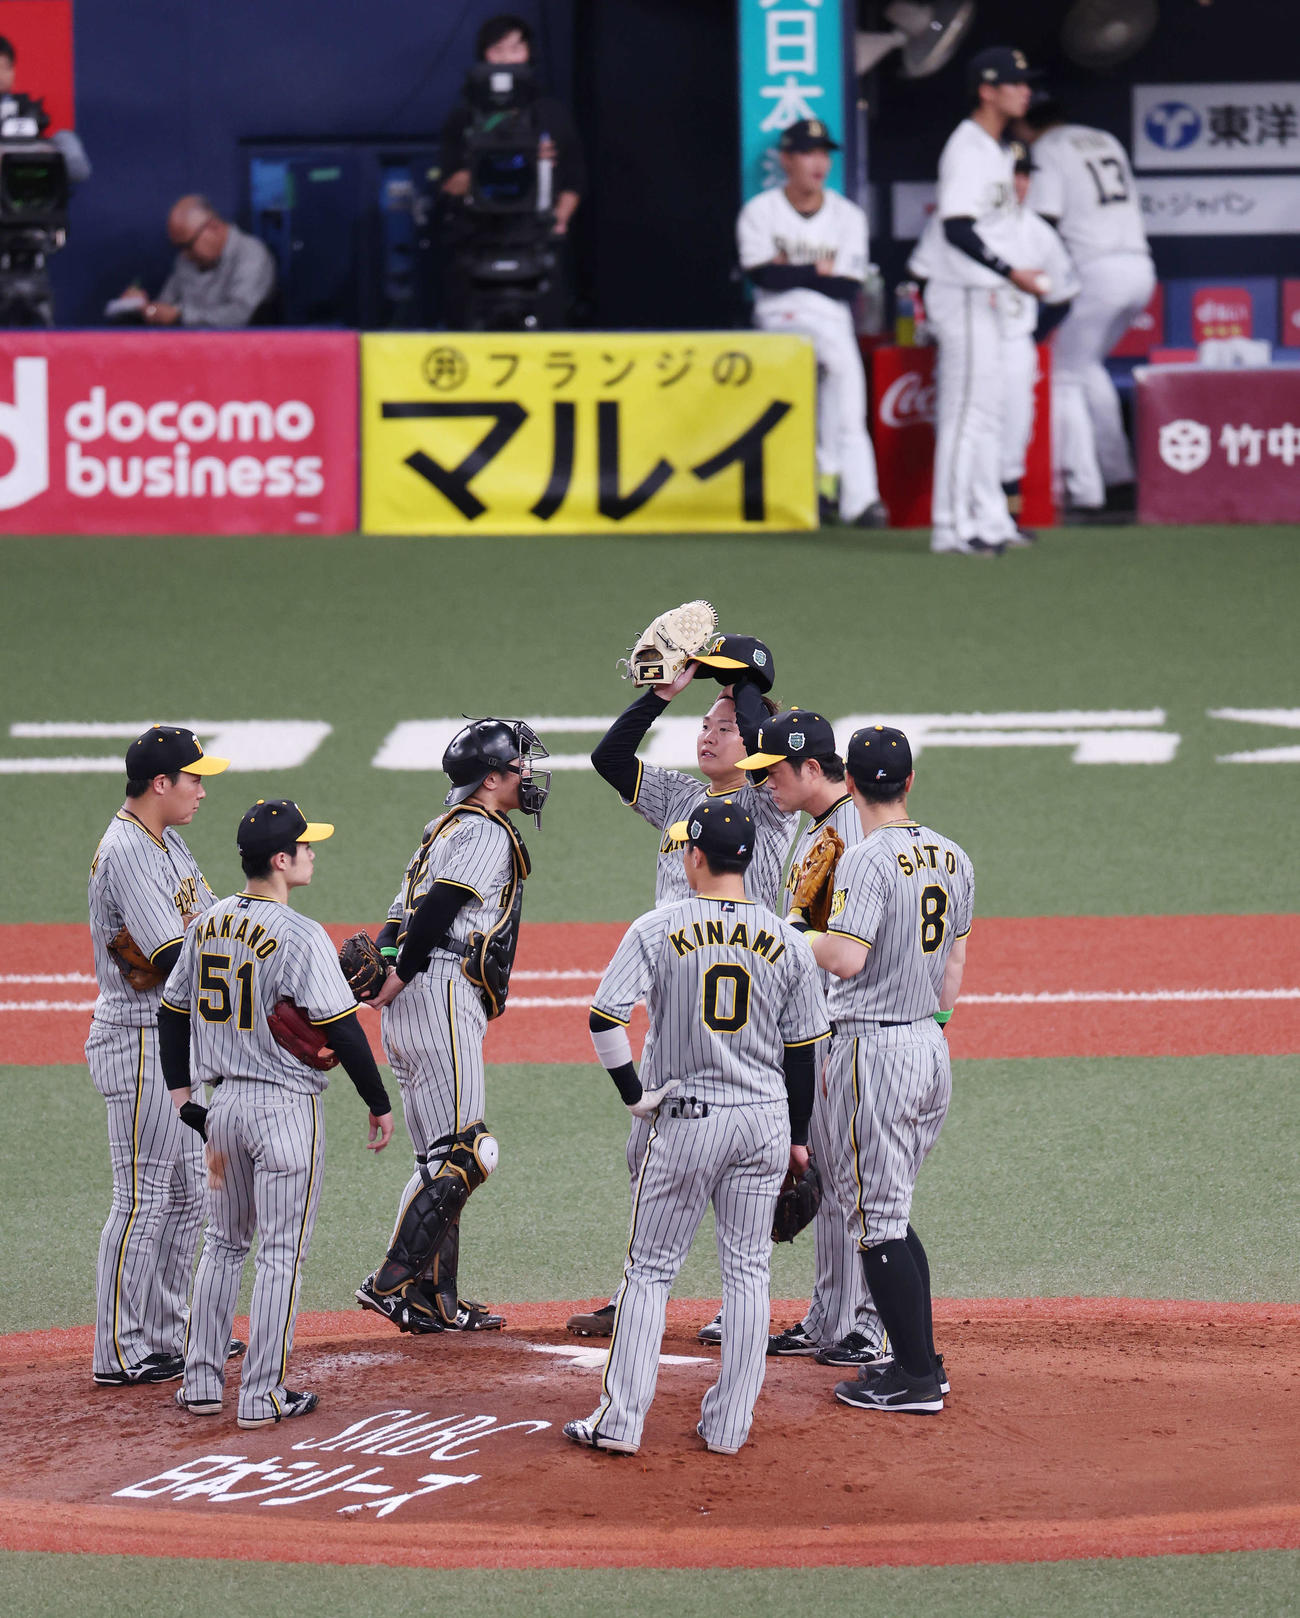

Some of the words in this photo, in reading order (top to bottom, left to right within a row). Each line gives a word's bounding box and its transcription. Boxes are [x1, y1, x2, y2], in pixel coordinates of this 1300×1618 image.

[1208, 104, 1298, 147] 東洋
[1085, 157, 1128, 206] 13
[489, 350, 754, 388] フランジの
[65, 386, 314, 442] docomo
[66, 442, 324, 497] business
[381, 399, 794, 522] マルイ
[1219, 422, 1300, 466] 竹中
[897, 845, 956, 876] SATO
[196, 913, 278, 960] NAKANO
[669, 920, 786, 965] KINAMI
[921, 884, 948, 954] 8
[198, 952, 254, 1031] 51
[703, 963, 751, 1034] 0
[291, 1409, 552, 1462] SMBC
